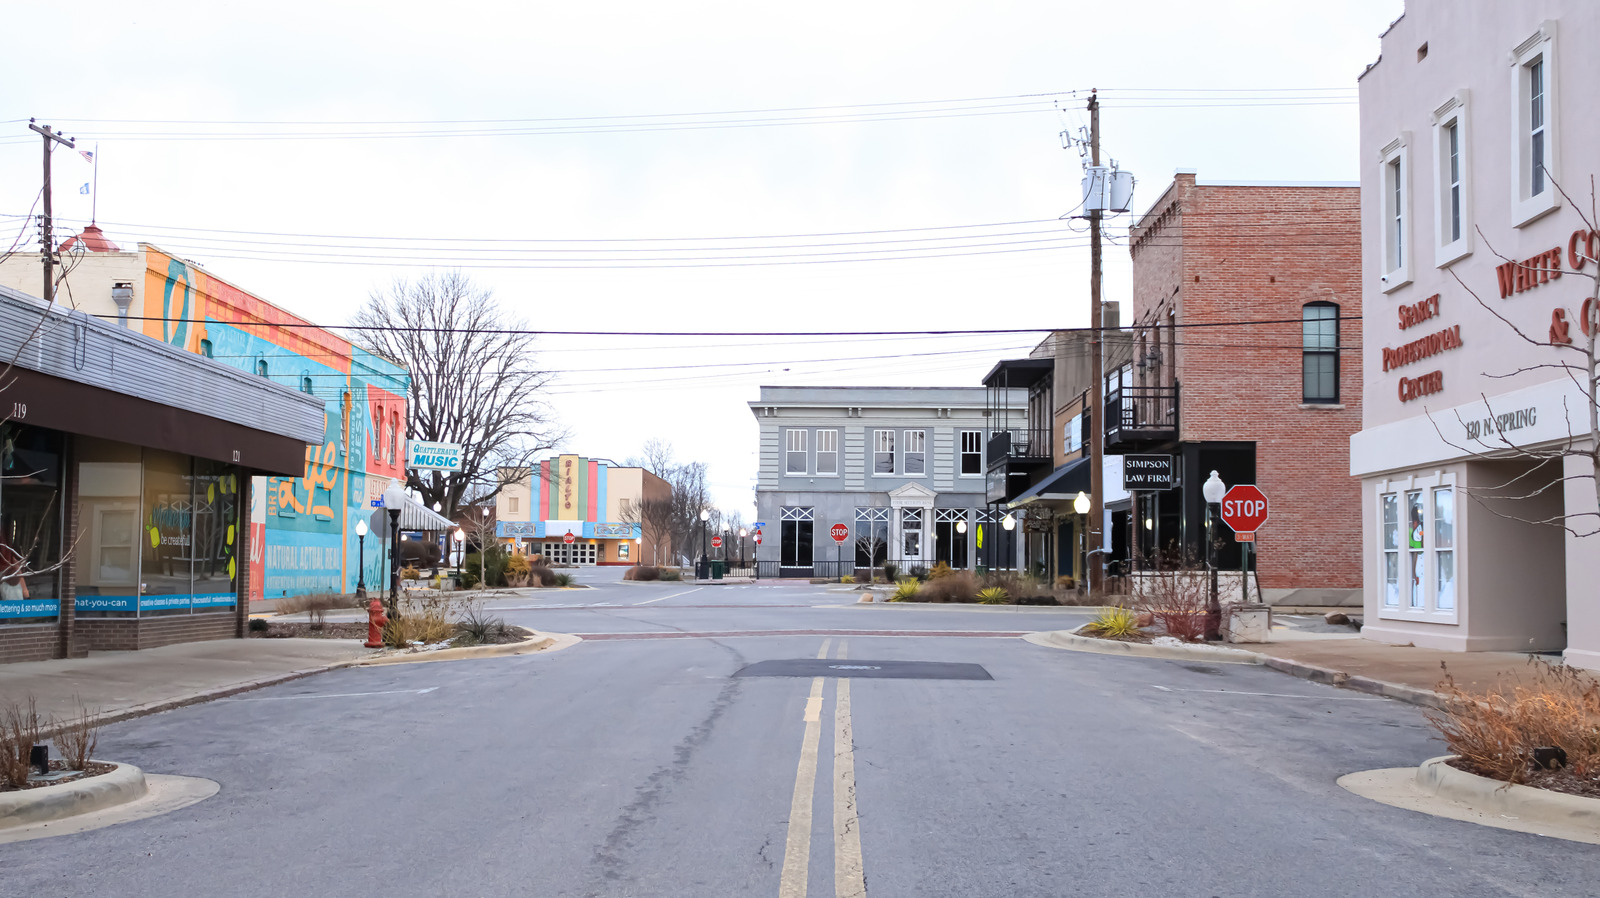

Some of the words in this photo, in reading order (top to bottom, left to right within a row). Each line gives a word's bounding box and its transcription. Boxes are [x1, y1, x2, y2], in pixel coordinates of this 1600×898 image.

[1496, 247, 1561, 298] WHITE
[1398, 293, 1440, 330] SEARCY
[1382, 324, 1463, 372] PROFESSIONAL
[1398, 370, 1443, 402] CENTER
[13, 402, 27, 419] 119
[355, 388, 363, 462] JESUS
[1466, 420, 1480, 440] 120
[1483, 417, 1494, 436] N.
[1496, 407, 1536, 432] SPRING
[413, 454, 459, 467] MUSIC
[1126, 460, 1169, 468] SIMPSON
[564, 460, 572, 509] RIALTO
[1125, 474, 1145, 482] LAW
[1147, 474, 1170, 482] FIRM
[1224, 500, 1265, 517] STOP
[831, 528, 848, 536] STOP
[267, 545, 298, 570] NATURAL
[299, 546, 324, 570] ACTUAL
[325, 547, 340, 570] REAL
[20, 604, 25, 613] &
[31, 603, 45, 612] much
[45, 604, 57, 612] more
